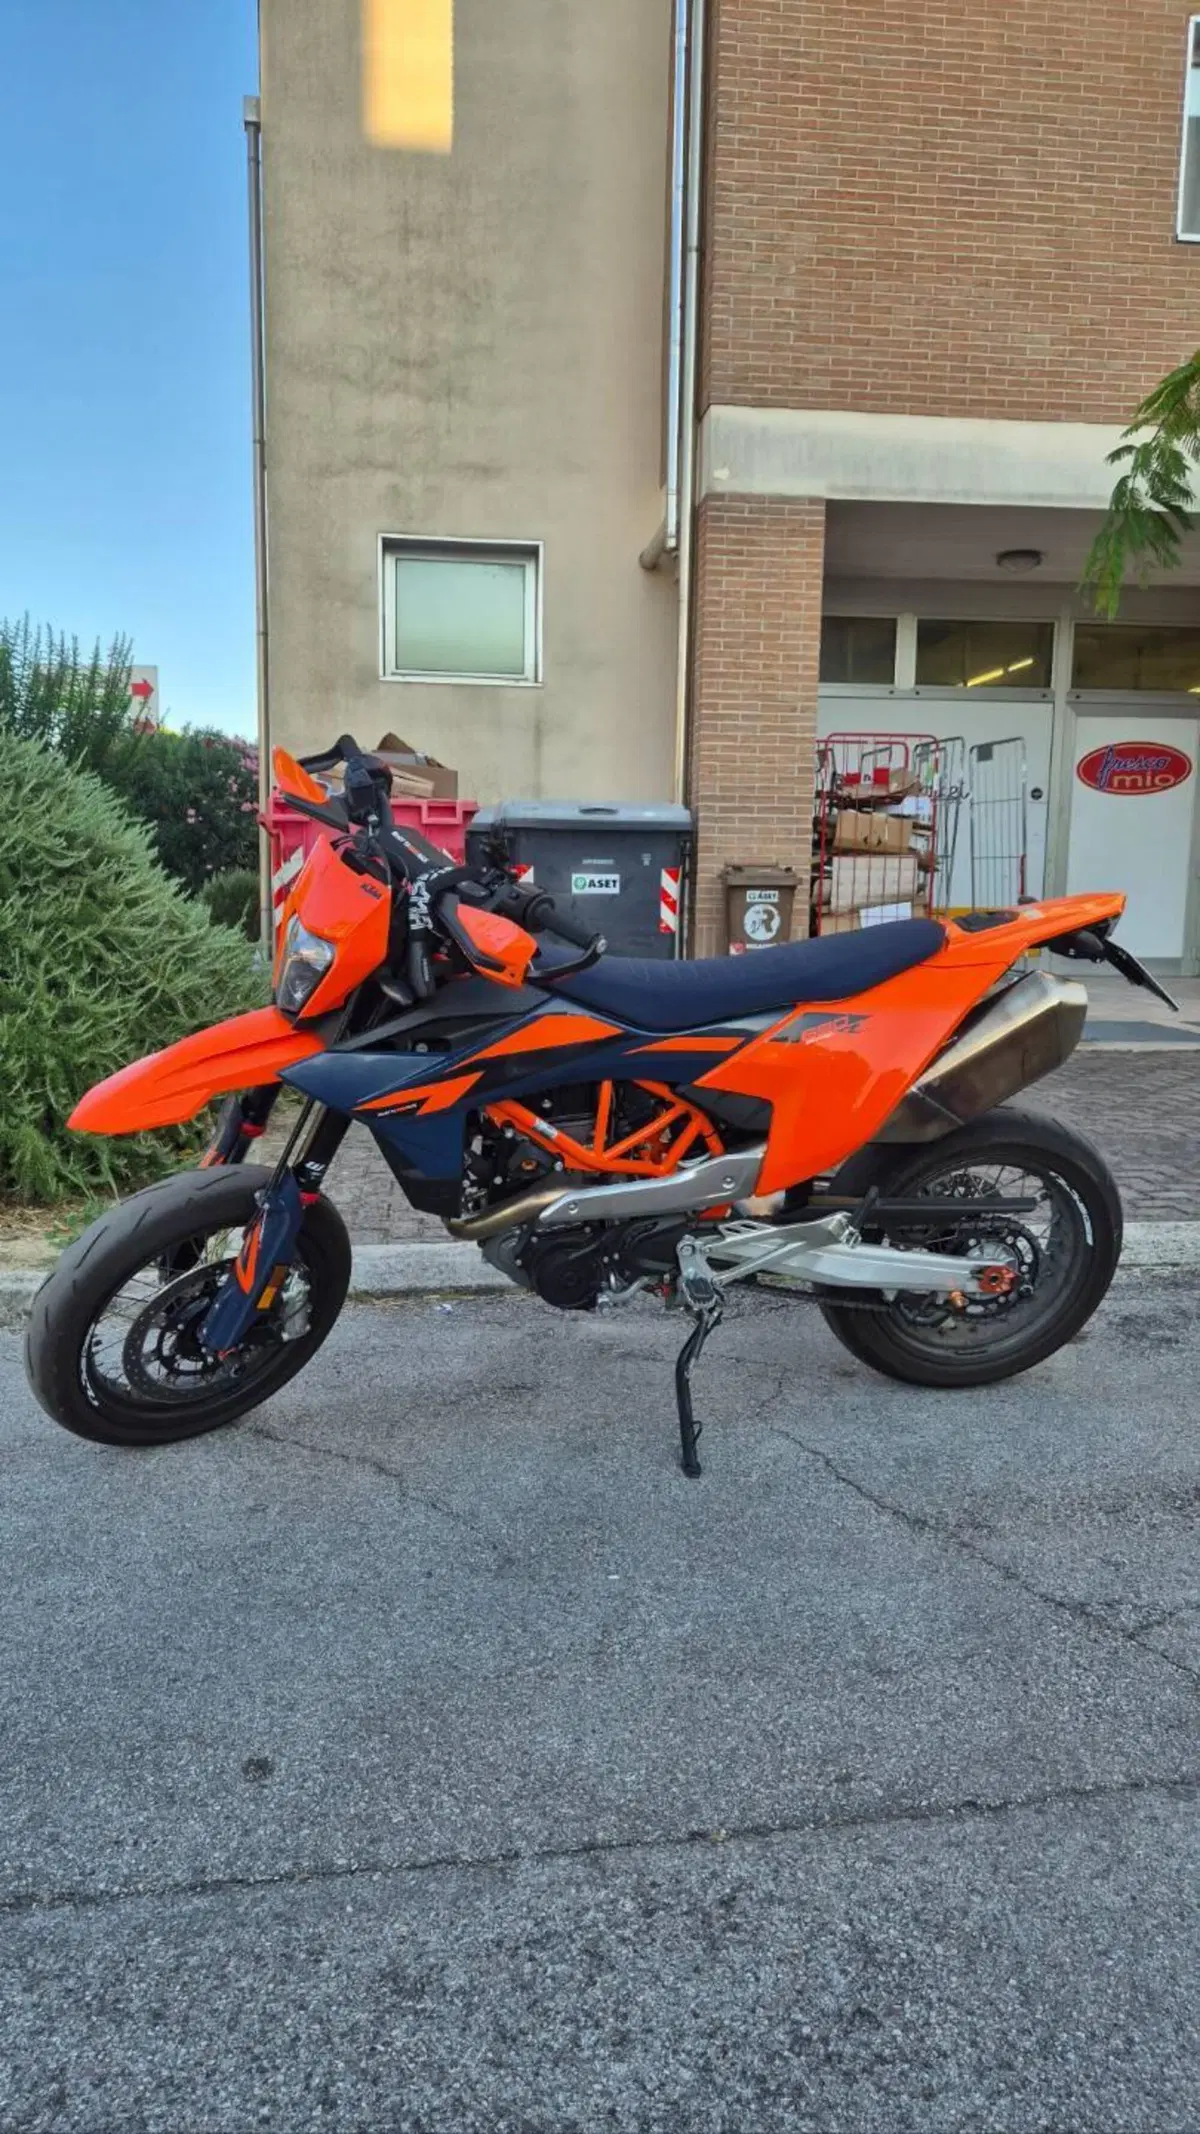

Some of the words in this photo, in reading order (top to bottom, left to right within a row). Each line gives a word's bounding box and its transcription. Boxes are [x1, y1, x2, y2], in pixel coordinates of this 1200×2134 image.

[1097, 744, 1172, 791] fresco
[1112, 769, 1175, 788] mio
[587, 878, 617, 889] ASET
